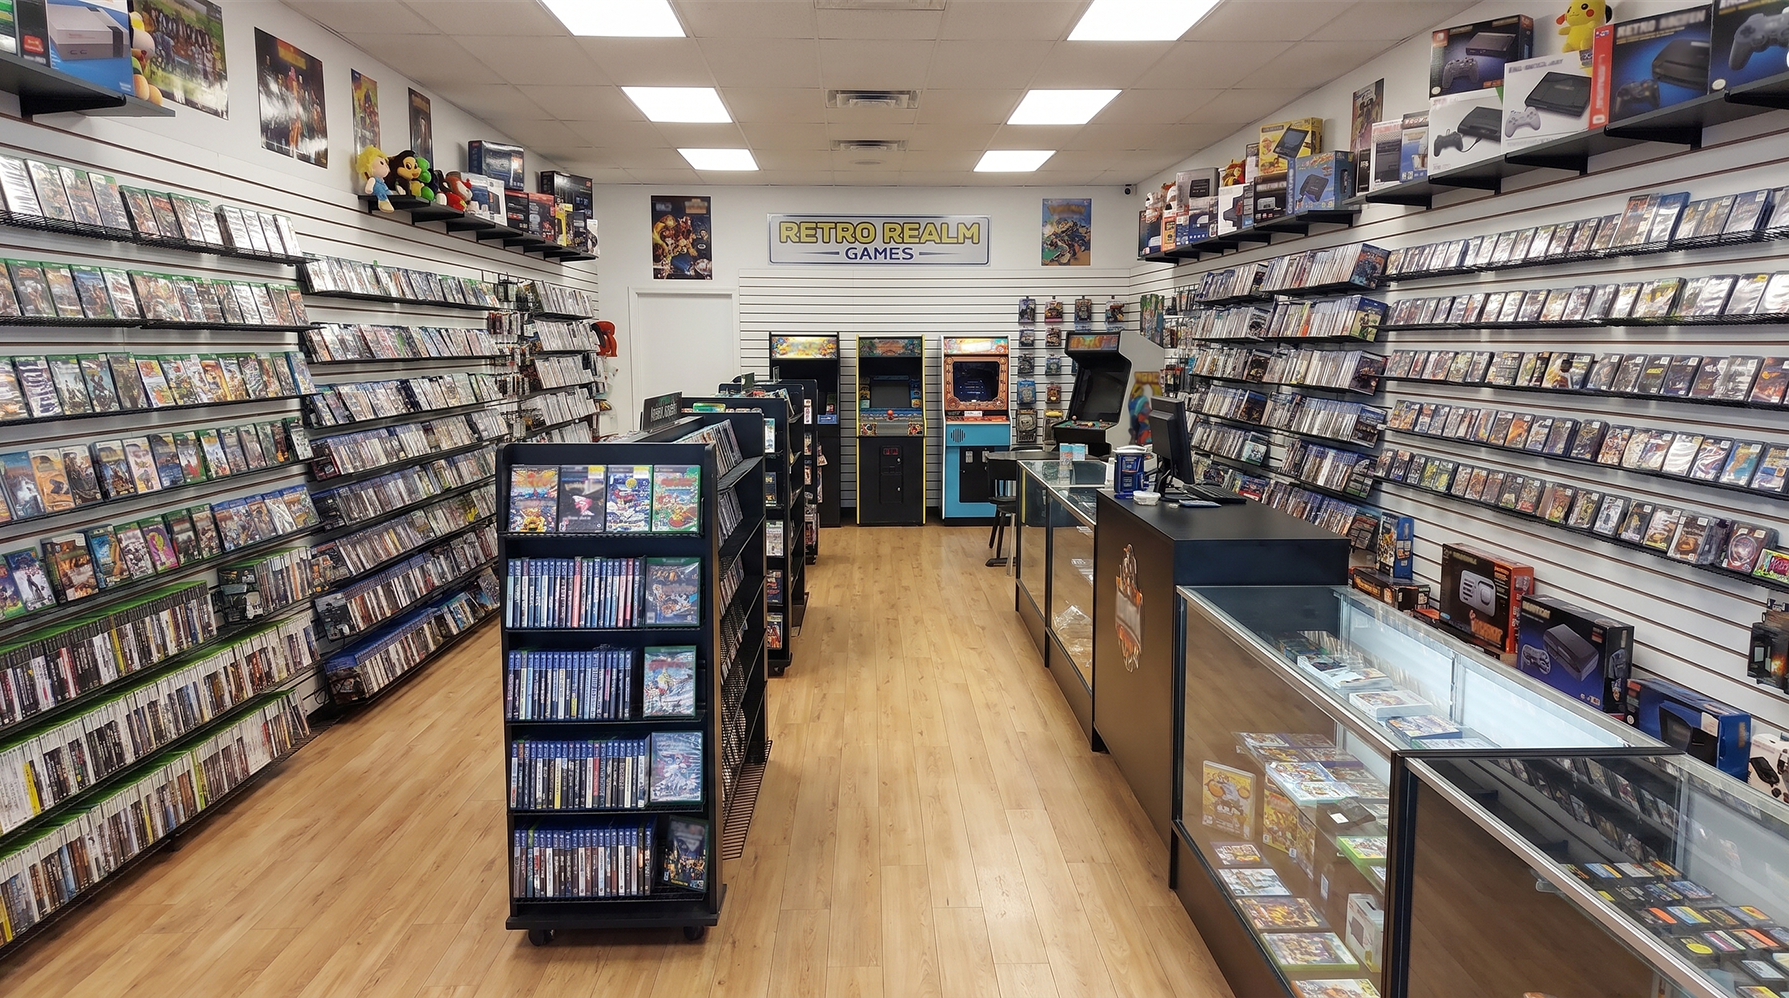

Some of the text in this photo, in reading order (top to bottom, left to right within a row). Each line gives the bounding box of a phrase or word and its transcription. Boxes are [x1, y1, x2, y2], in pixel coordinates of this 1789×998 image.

[779, 221, 980, 245] RETRO REALM
[845, 247, 914, 260] GAMES
